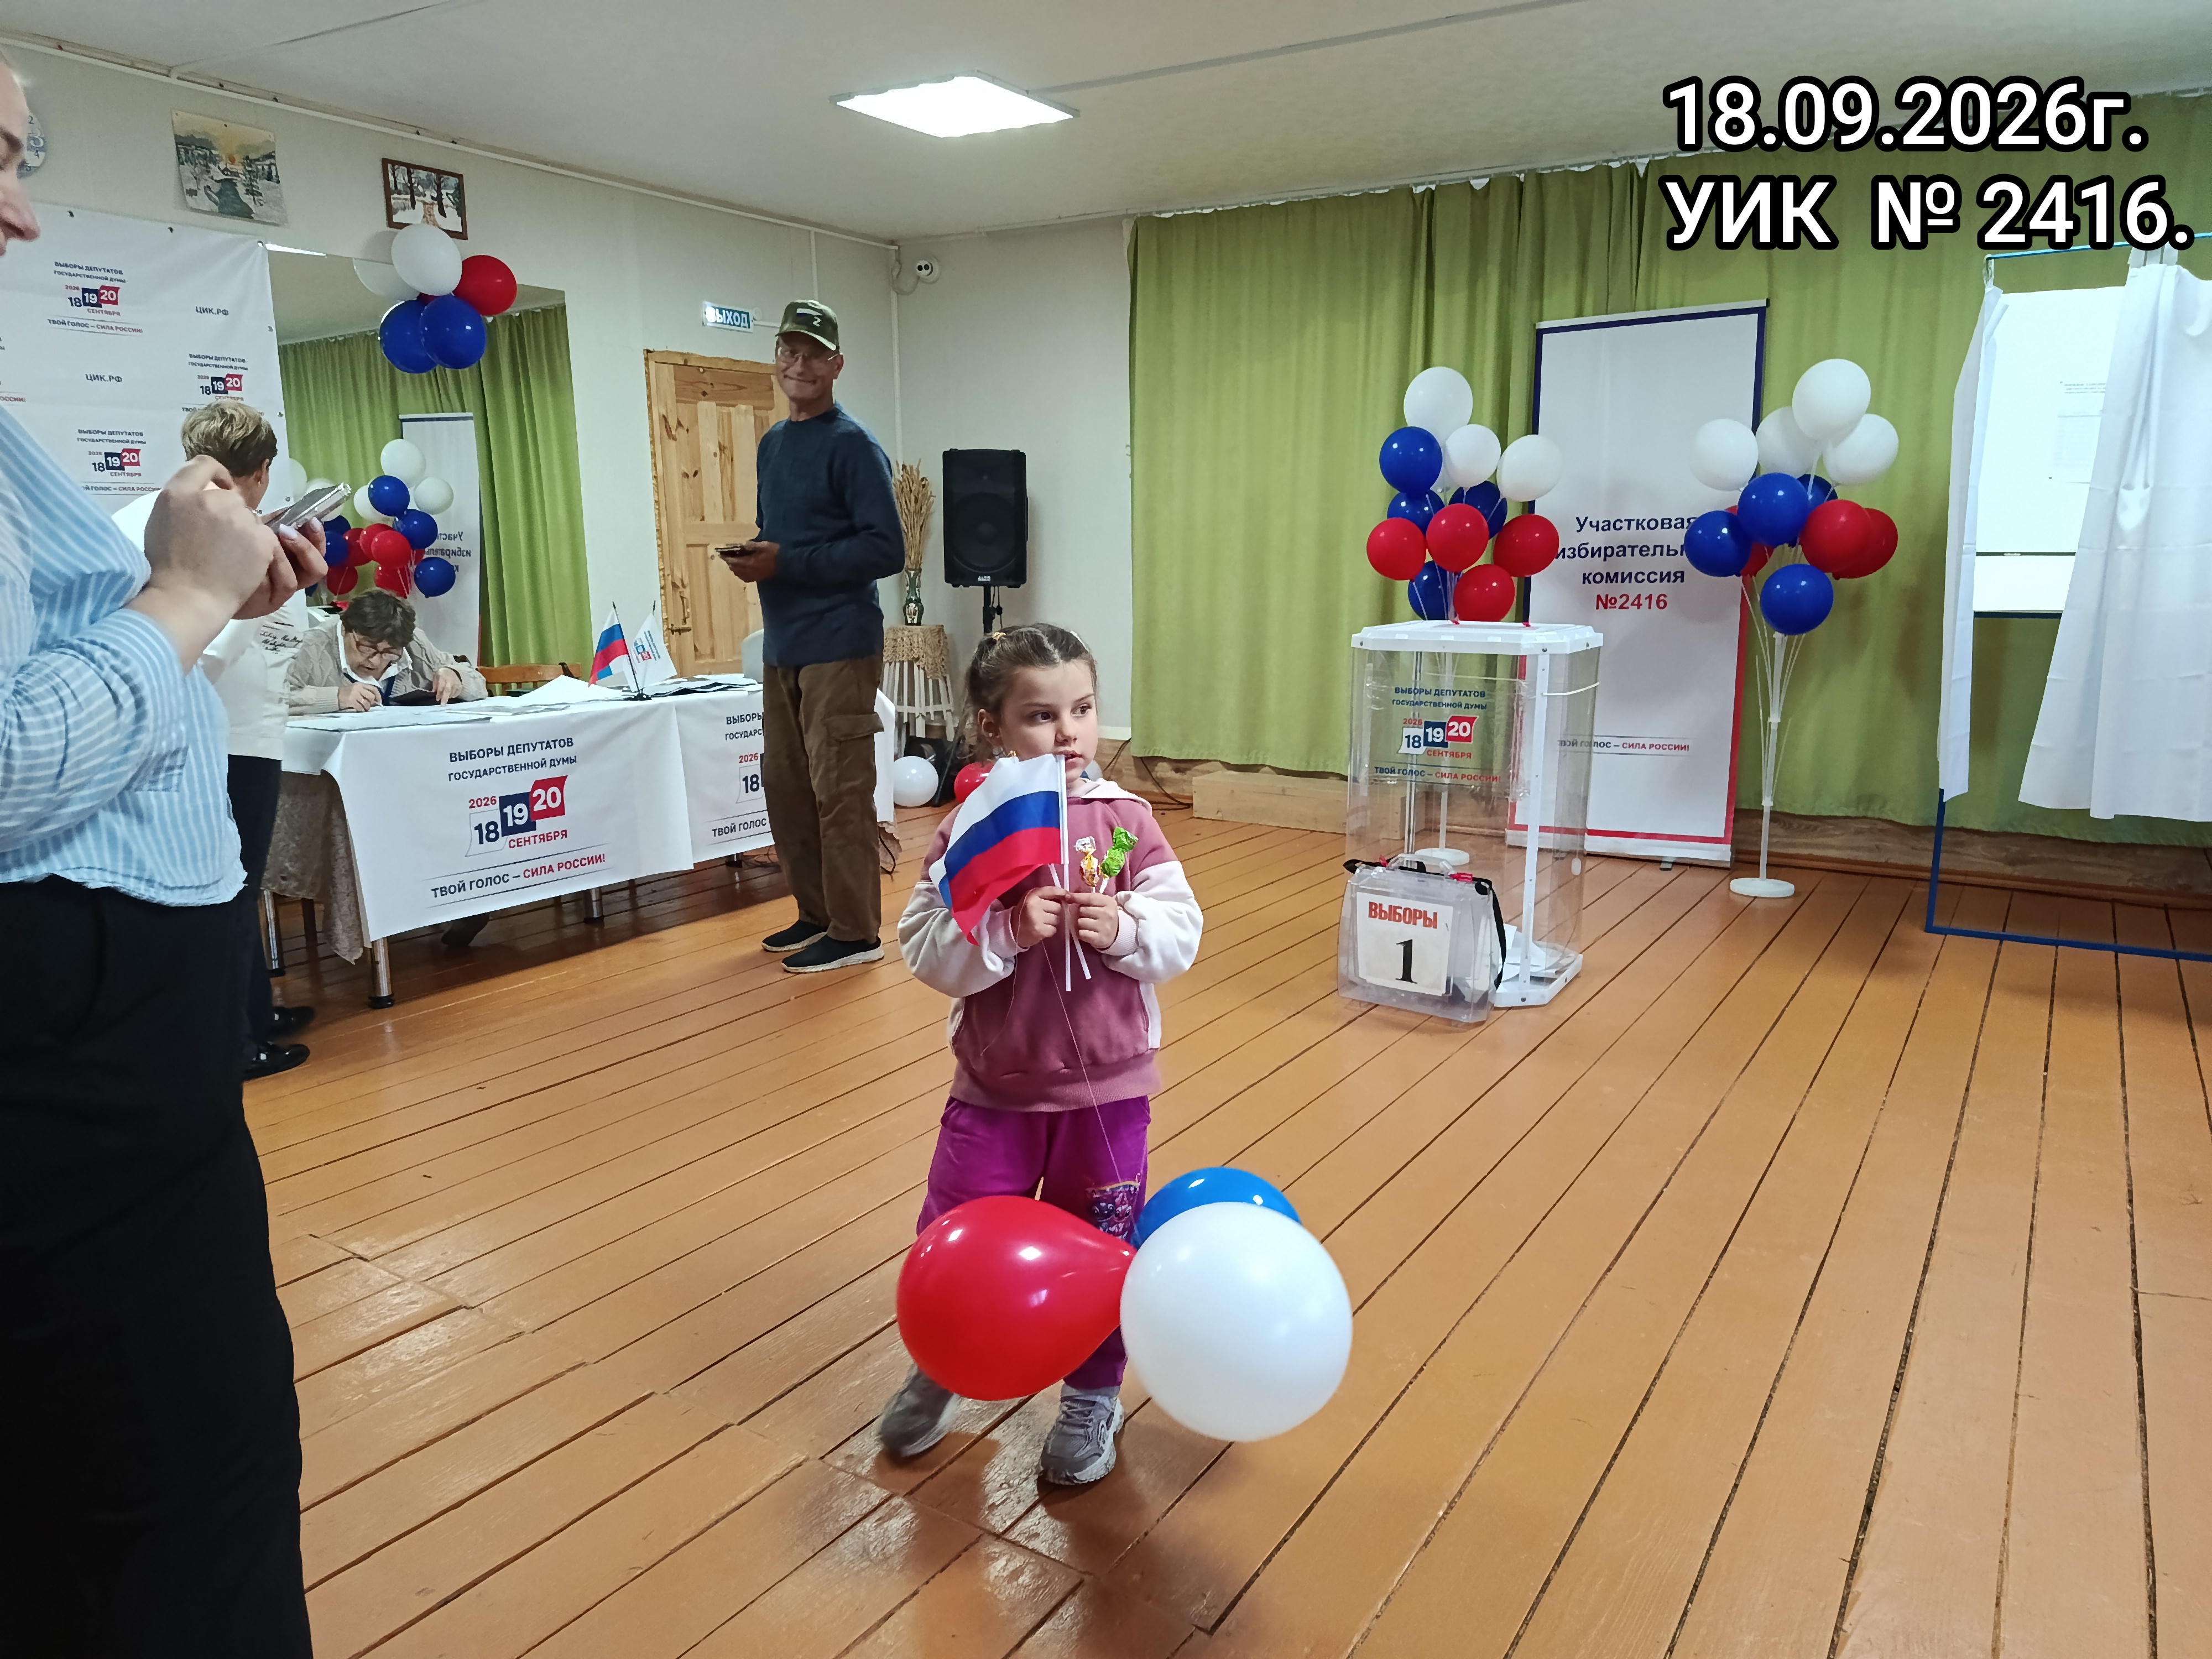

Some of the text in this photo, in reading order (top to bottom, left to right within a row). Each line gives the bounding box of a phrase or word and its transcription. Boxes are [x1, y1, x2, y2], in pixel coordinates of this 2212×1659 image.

[54, 262, 123, 275] ВЫБОРЫ ДЕПУТАТОВ
[54, 270, 108, 281] ГОСУДАРСТВЕННОЙ
[67, 290, 117, 307] 18 19 20
[87, 308, 121, 316] СЕНТЯБРЯ
[195, 306, 229, 316] ЦИК.РФ
[85, 374, 122, 383] ЦИК.РФ
[200, 377, 241, 395] 18 19 20
[92, 452, 138, 472] 18 19 20
[1555, 542, 1684, 562] избиратель
[1582, 571, 1684, 585] комиссия
[1595, 593, 1668, 610] №2416
[1395, 687, 1486, 698] ВЫБОРЫ ДЕПУТАТОВ
[1392, 699, 1462, 708] ГОСУДАРСТВЕННОЙ
[725, 728, 763, 741] ГОСУДАРС
[1405, 721, 1471, 749] 18 19 20
[449, 737, 574, 763] ВЫБОРЫ ДЕПУТАТОВ
[1427, 749, 1472, 759] СЕНТЯБРЯ
[1648, 743, 1689, 752] РОССИИ!
[739, 753, 759, 764] 2026
[448, 755, 577, 782] ГОСУДАРСТВЕННОЙ ДУМЫ
[1374, 766, 1396, 775] ТВОЙ
[1397, 768, 1425, 777] ГОЛОС
[1435, 771, 1458, 780] СИЛА
[1461, 774, 1501, 782] РОССИИ!
[742, 774, 760, 794] 18
[468, 795, 497, 809] 2026
[474, 786, 561, 844] 18 19 20
[712, 818, 767, 837] ТВОЙ ГОЛОС
[508, 830, 568, 849] СЕНТЯБРЯ
[431, 880, 466, 899] ТВОЙ
[469, 874, 510, 891] ГОЛОС
[523, 864, 555, 879] СИЛА
[557, 853, 606, 872] РОССИИ!
[1368, 901, 1438, 930] ВЫБОРЫ
[1395, 939, 1418, 984] 1
